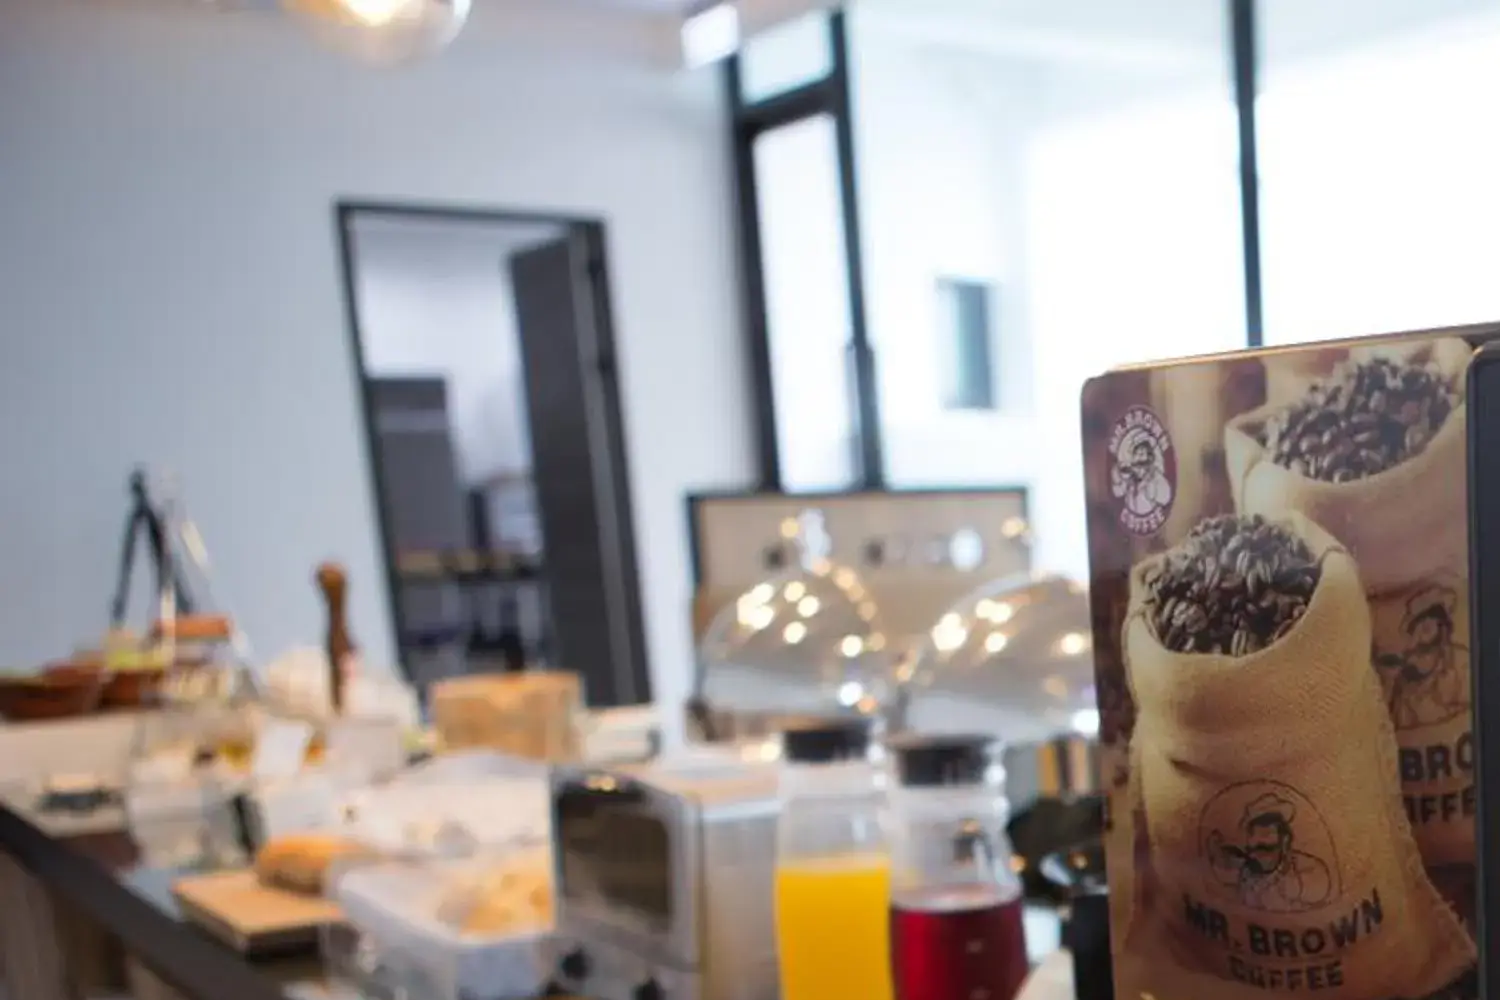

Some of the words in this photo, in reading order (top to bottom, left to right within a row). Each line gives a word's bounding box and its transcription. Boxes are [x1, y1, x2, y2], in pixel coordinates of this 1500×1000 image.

[1125, 410, 1169, 452] BROWN
[1120, 506, 1165, 534] COFFEE
[1247, 888, 1385, 959] BROWN
[1228, 955, 1345, 992] COFFEE
